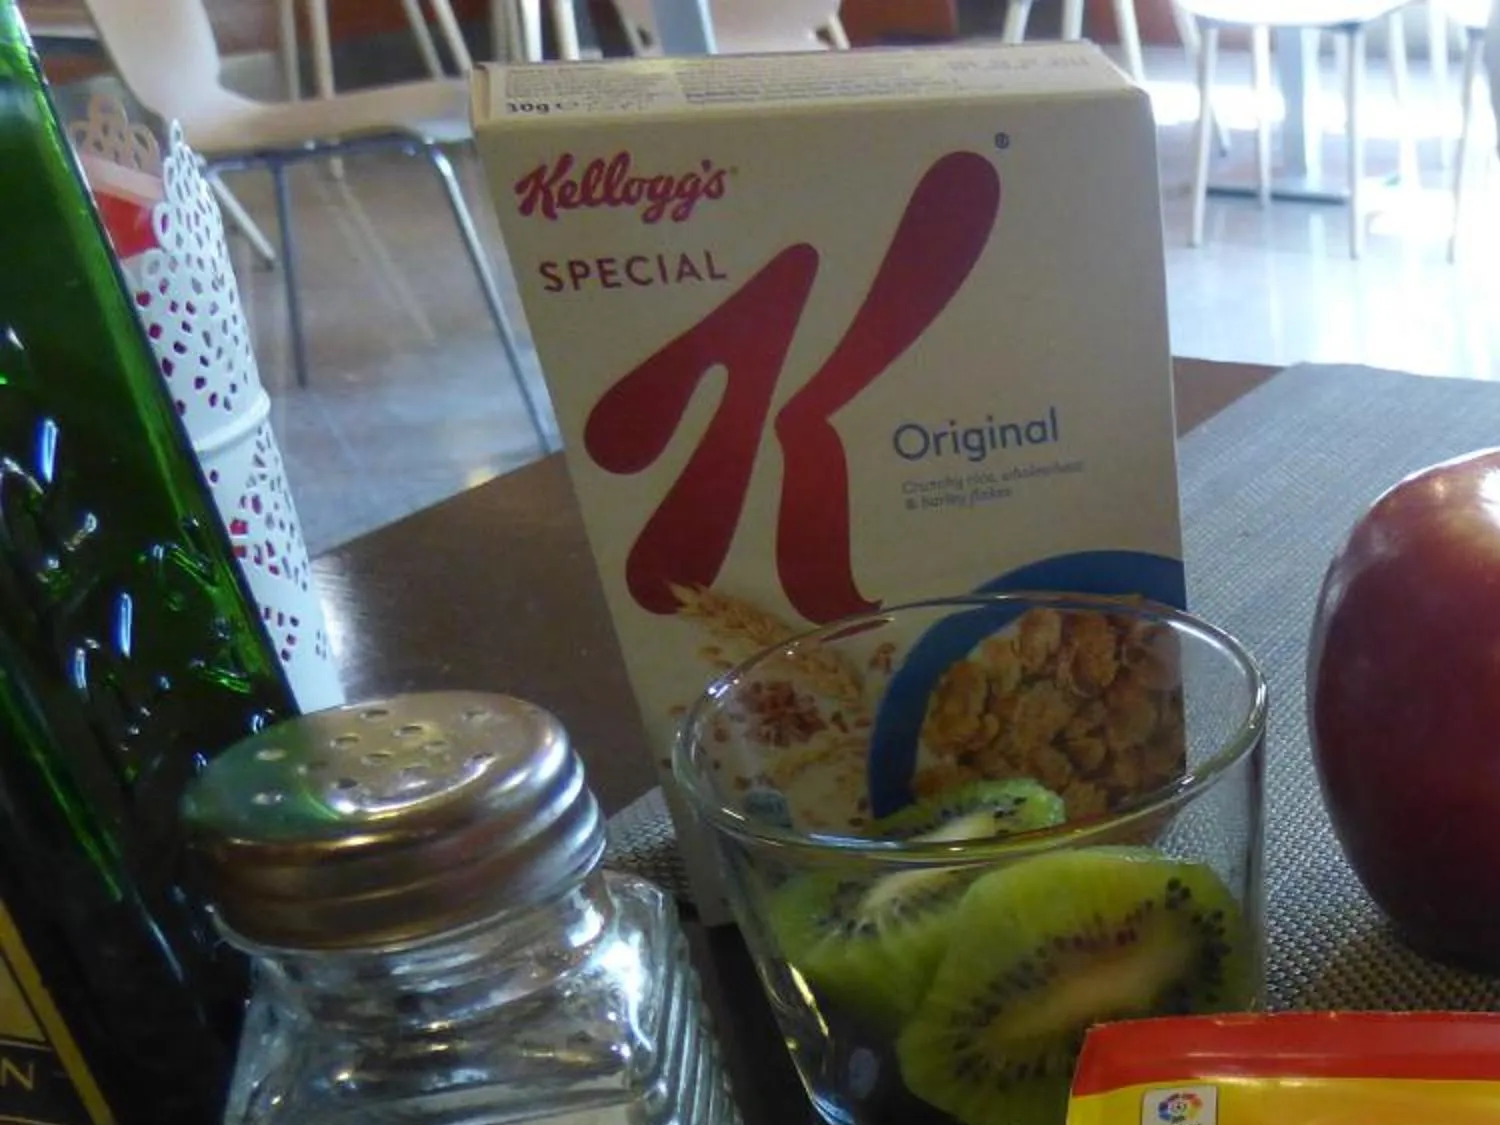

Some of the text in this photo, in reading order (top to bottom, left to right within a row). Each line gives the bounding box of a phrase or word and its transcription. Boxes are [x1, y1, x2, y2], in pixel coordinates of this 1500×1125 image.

[514, 151, 726, 222] Kellogg's
[539, 251, 728, 292] SPECIAL
[892, 405, 1060, 463] Original
